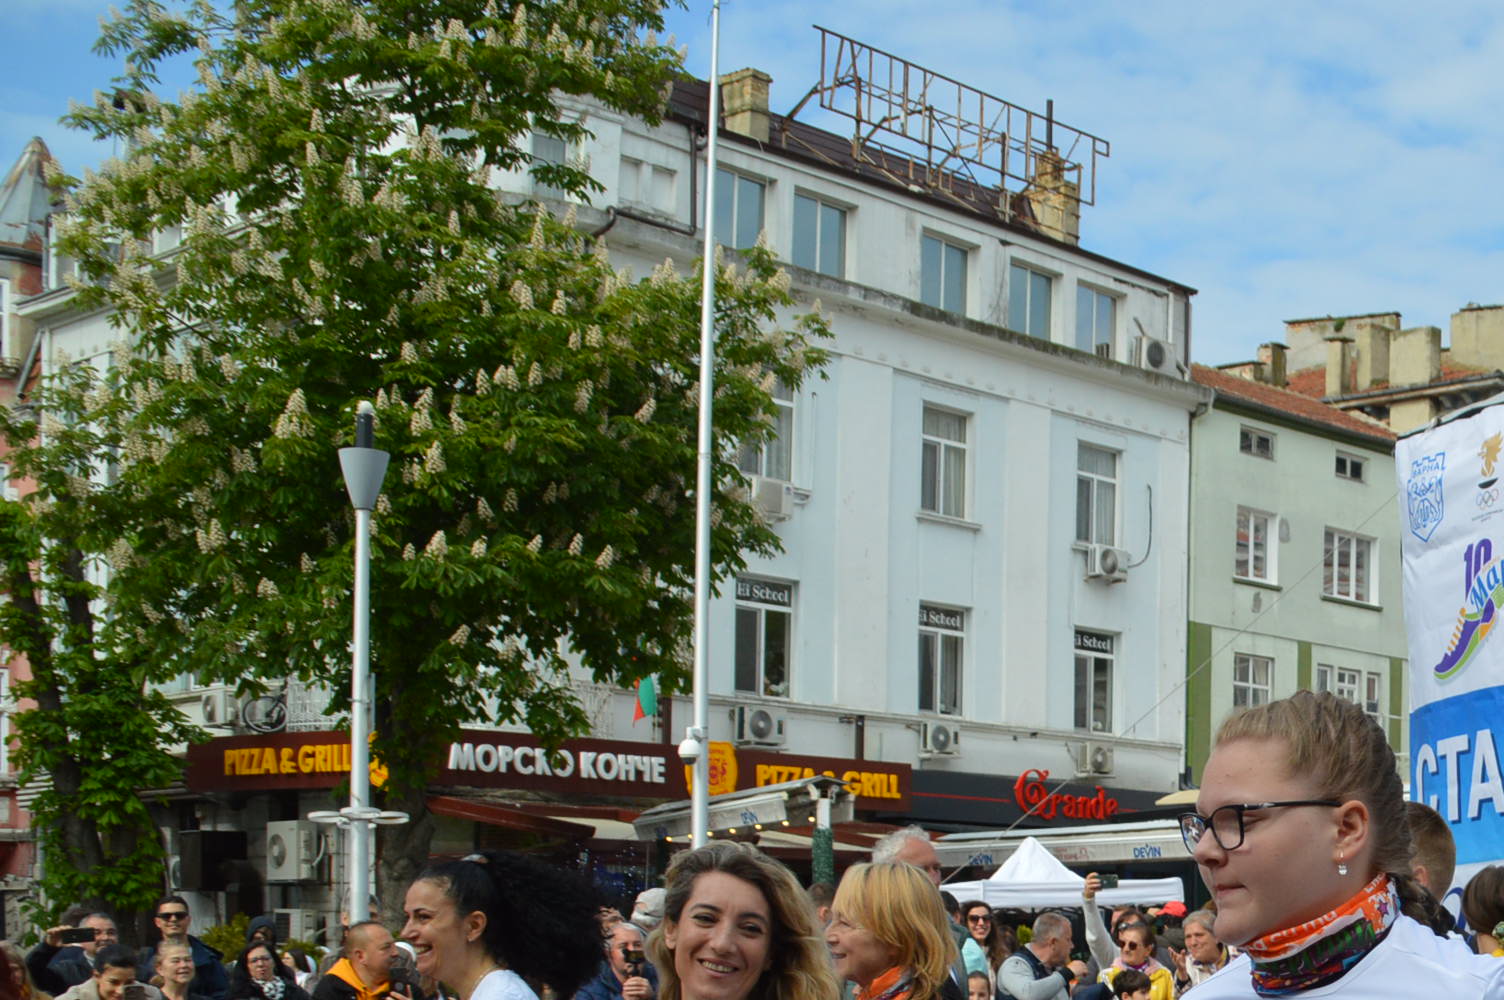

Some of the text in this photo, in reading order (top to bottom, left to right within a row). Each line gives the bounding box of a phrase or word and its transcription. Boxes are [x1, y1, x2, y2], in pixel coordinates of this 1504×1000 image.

[1463, 538, 1493, 601] 10
[752, 585, 789, 603] School
[929, 611, 962, 628] School
[1083, 635, 1112, 651] School
[224, 743, 351, 776] PIZZA & GRILL
[448, 742, 667, 784] МОРСКО КОНЧЕ
[843, 770, 902, 799] GRILL
[1014, 768, 1119, 821] Grande
[1133, 844, 1162, 858] DEVIN
